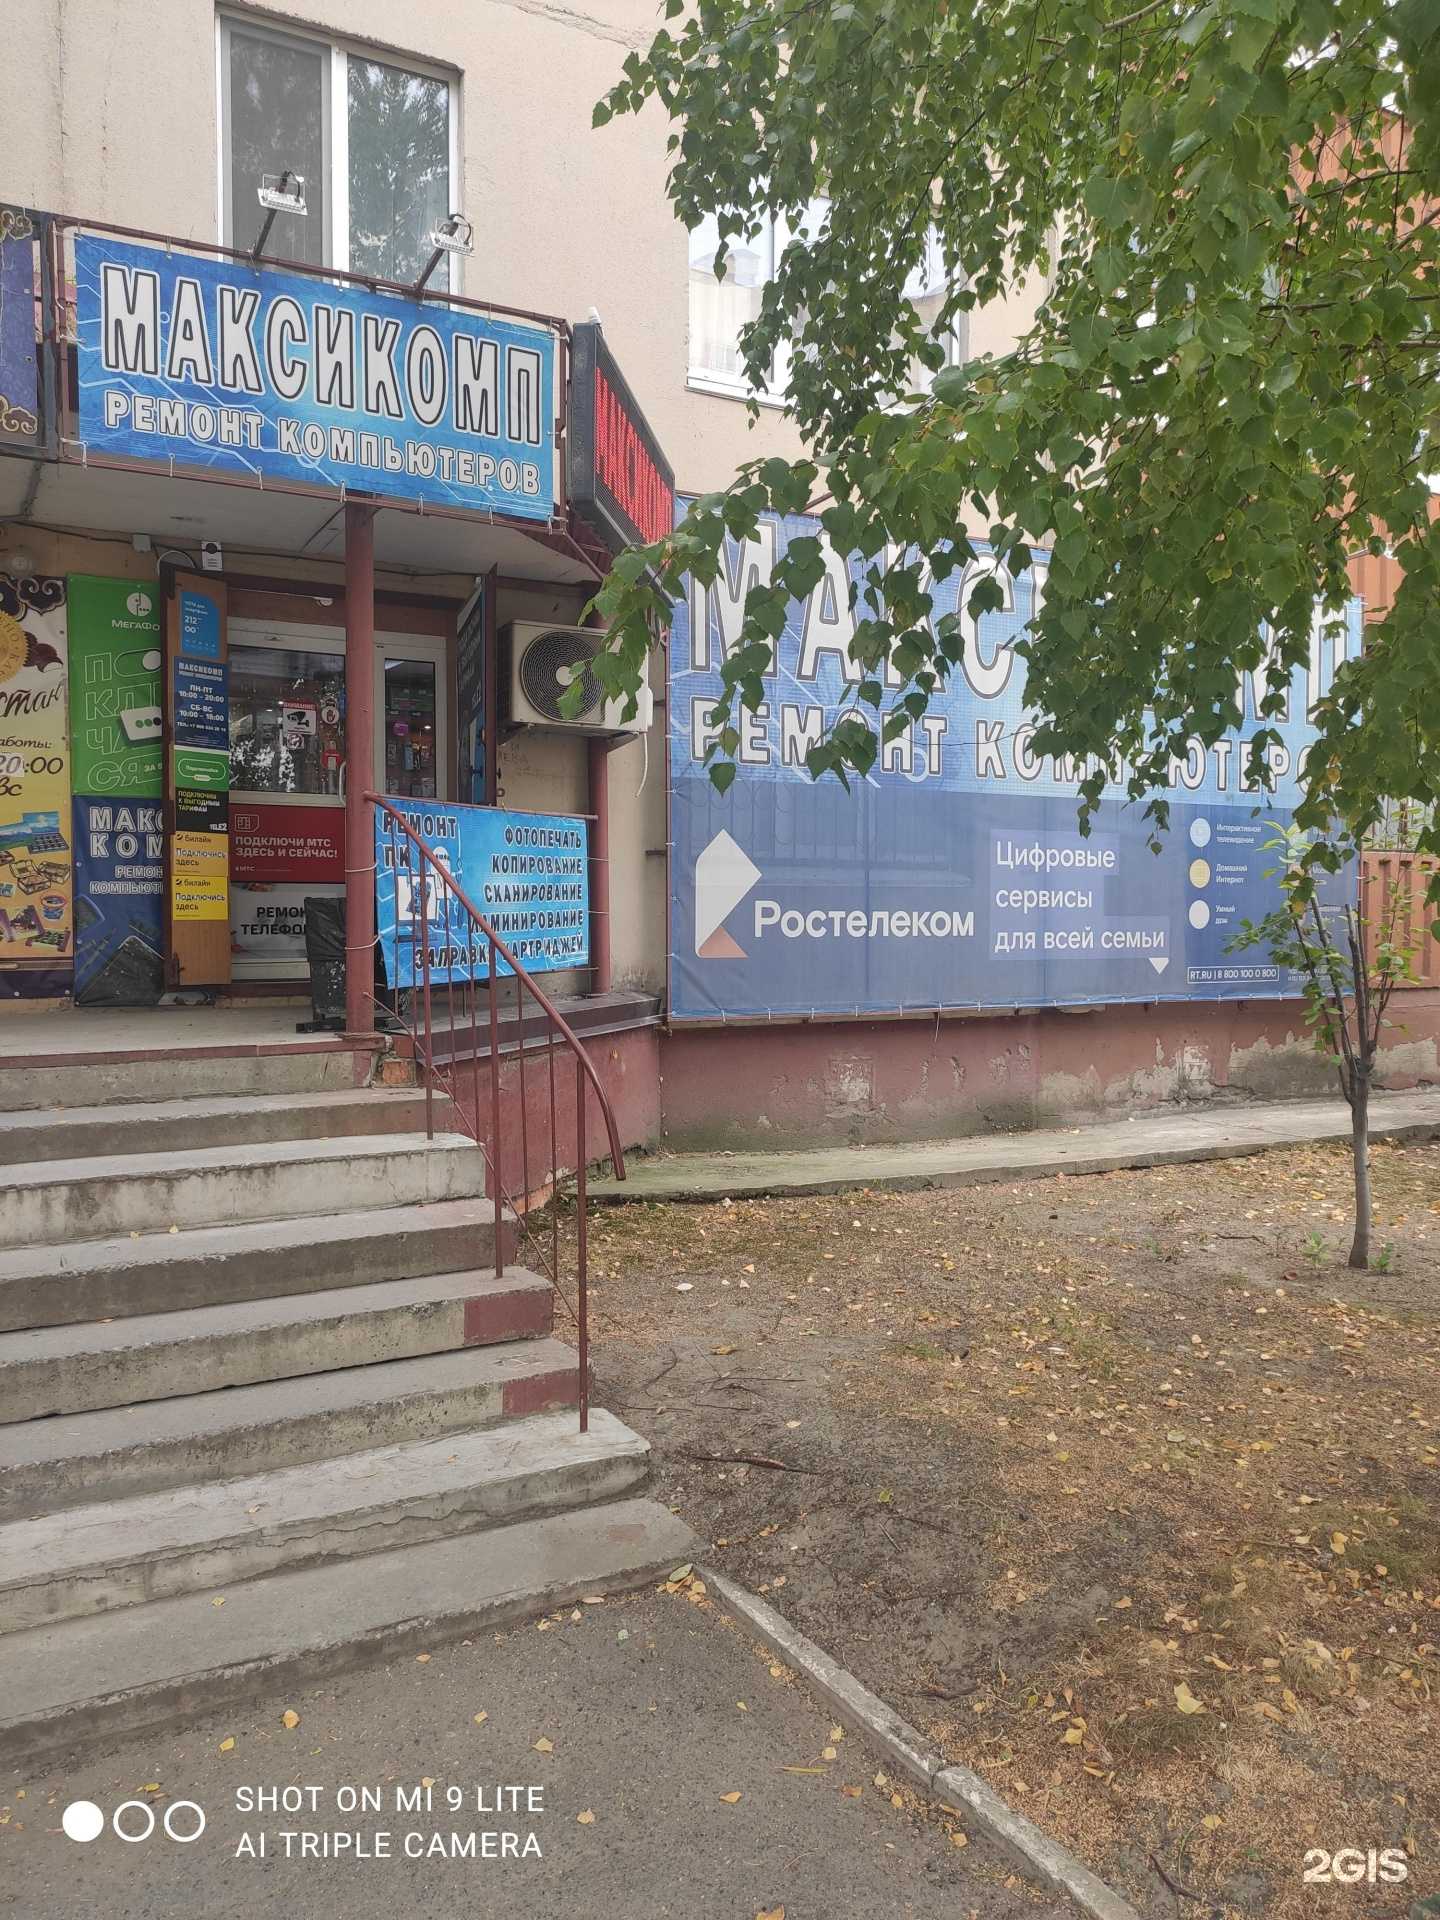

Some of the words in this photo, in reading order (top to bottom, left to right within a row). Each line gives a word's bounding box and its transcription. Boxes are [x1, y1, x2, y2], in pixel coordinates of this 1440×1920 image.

[101, 263, 544, 446] МАКСИКОМП
[104, 391, 264, 449] РЕМОНТ
[278, 416, 542, 496] КОМПЬЮТЕРОВ
[190, 684, 213, 693] ПН-ПТ
[205, 694, 224, 703] 20:00
[179, 710, 199, 718] 10:00
[190, 704, 213, 712] СБ-ВС
[235, 836, 304, 847] ПОДКЛЮЧИ
[306, 838, 332, 847] МТС
[505, 825, 581, 848] ФОТОПЕЧАТЬ
[235, 847, 275, 858] ЗДЕСЬ
[278, 849, 287, 857] И
[288, 847, 338, 858] СЕЙЧАС!
[996, 840, 1116, 873] Цифровые
[491, 853, 583, 875] КОПИРОВАНИЕ
[89, 881, 164, 894] КОМПЬЮТ
[484, 883, 583, 903] СКАНИРОВАНИЕ
[995, 886, 1093, 914] сервисы
[176, 903, 199, 911] здесь
[753, 900, 975, 938] Ростелеком
[240, 923, 306, 936] ТЕЛЕФО
[994, 928, 1037, 953] для
[1043, 926, 1095, 950] всей
[1100, 929, 1165, 949] семьи
[414, 945, 494, 971] ЗАПРАВК
[1190, 970, 1212, 980] RT.RU
[1224, 969, 1239, 979] 800
[1240, 969, 1253, 978] 100
[1261, 968, 1277, 977] 800
